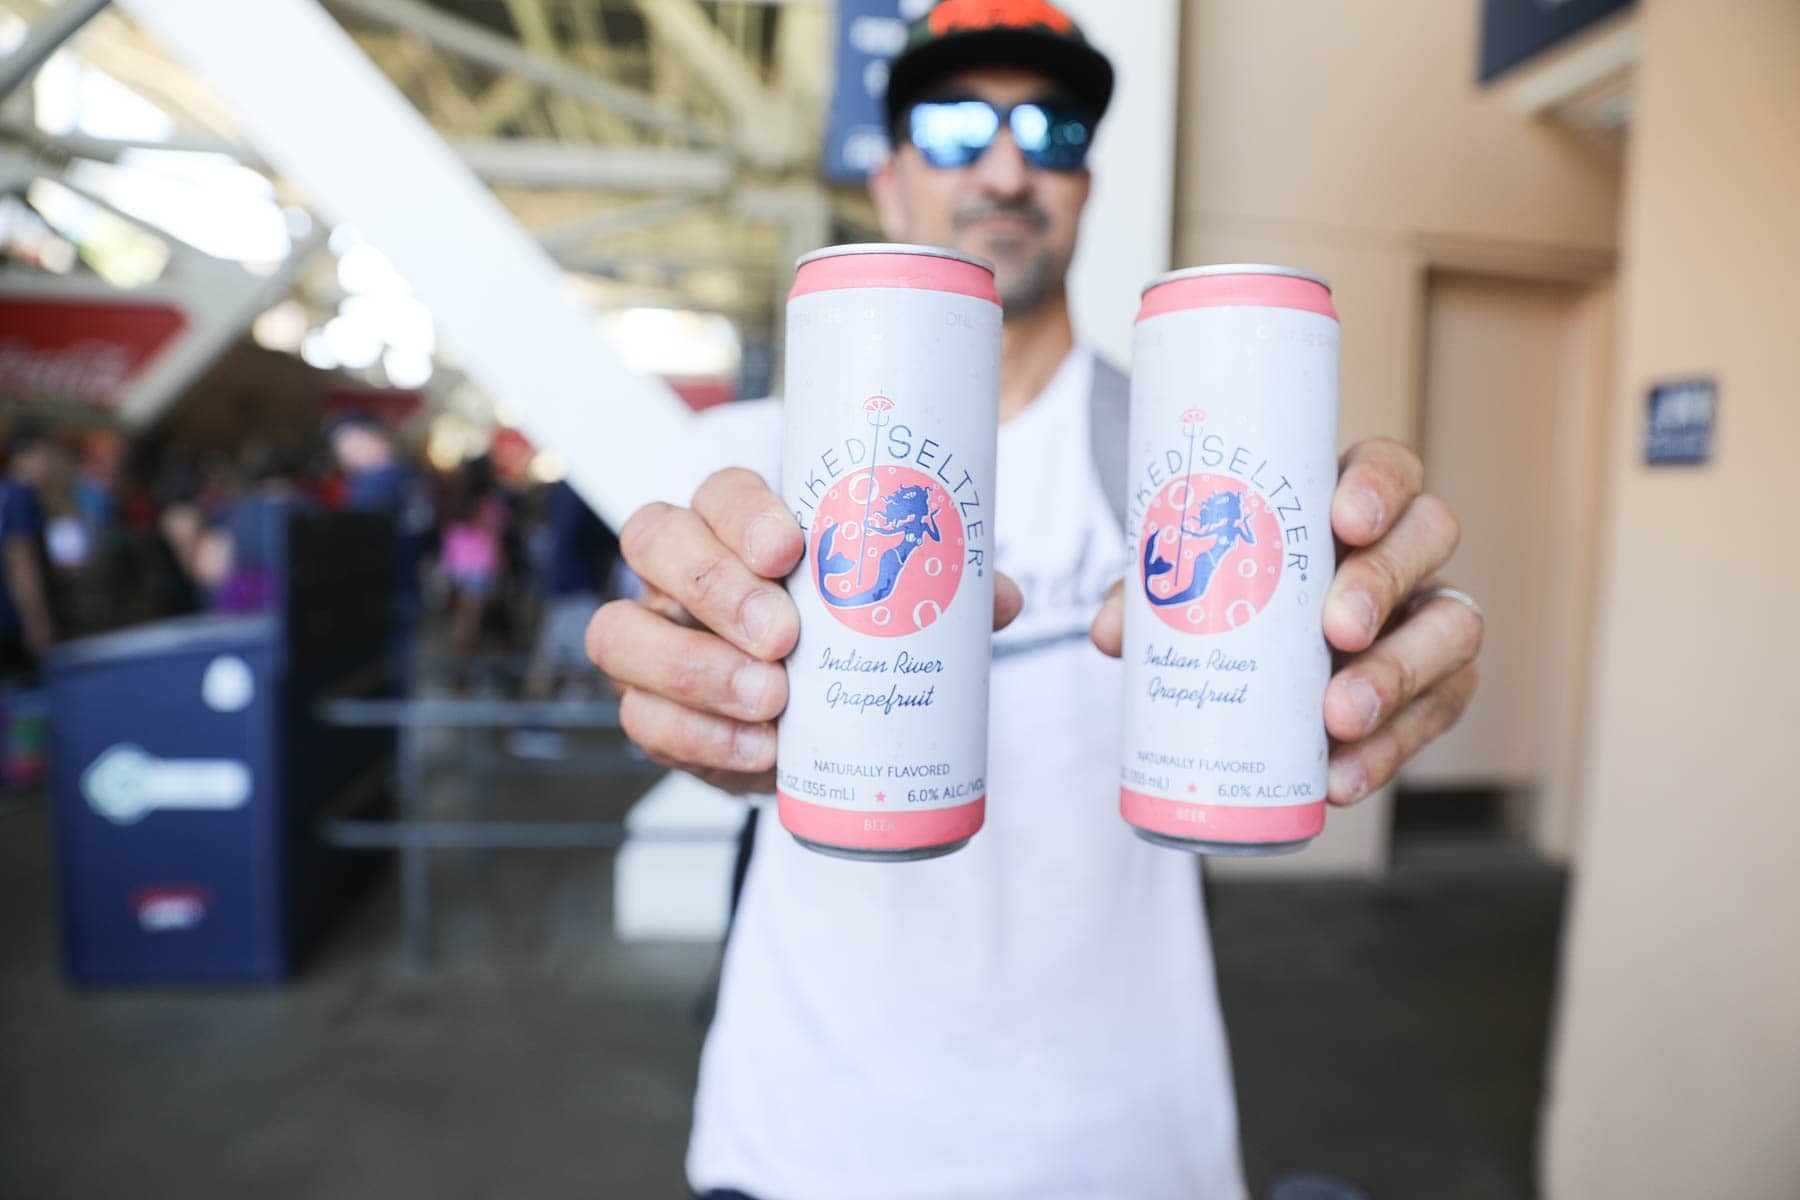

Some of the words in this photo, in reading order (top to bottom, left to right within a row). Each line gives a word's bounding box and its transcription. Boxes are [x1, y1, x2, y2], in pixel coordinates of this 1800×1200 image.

[793, 438, 867, 531] PIKED
[819, 647, 888, 673] Indian
[894, 650, 944, 674] River
[1144, 643, 1200, 669] Indian
[1206, 648, 1258, 673] River
[826, 681, 935, 715] Grapefruit
[1148, 676, 1249, 709] Grapefruit
[814, 759, 883, 778] NATURALLY
[887, 763, 951, 778] FLAVORED
[1137, 751, 1194, 770] NATURALLY
[1199, 759, 1266, 774] FLAVORED
[907, 787, 940, 803] 6.0%
[1217, 783, 1252, 798] 6.0%
[863, 817, 896, 832] BEER
